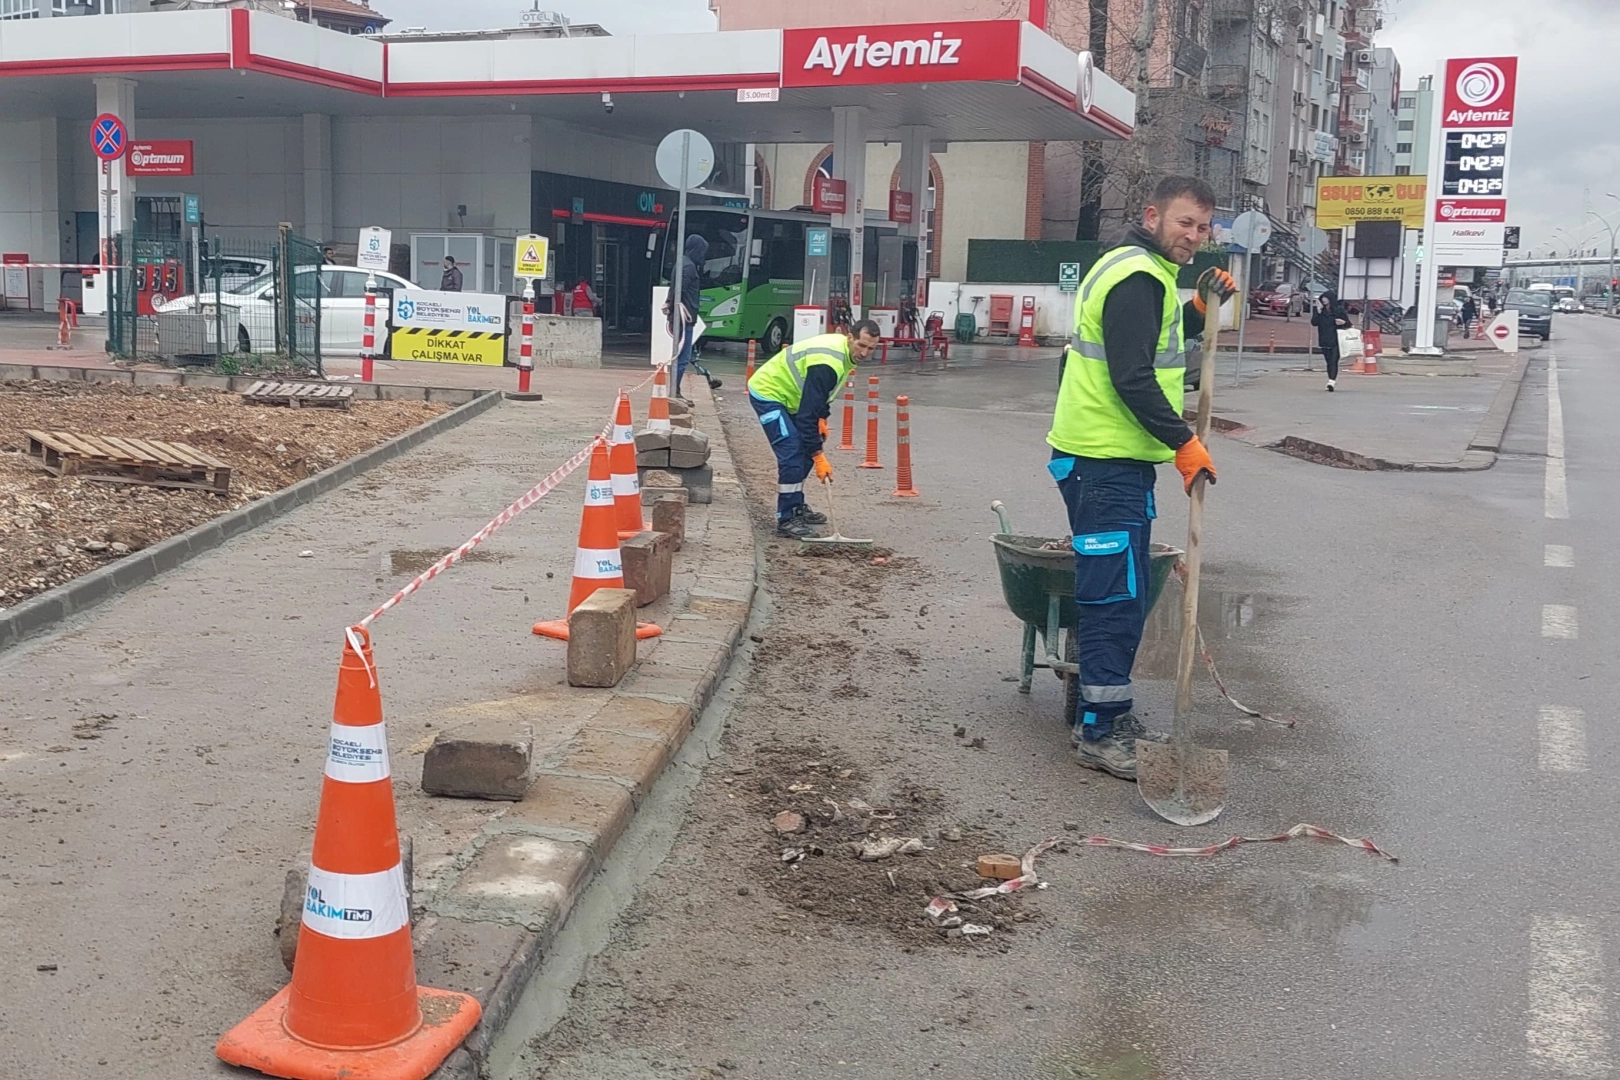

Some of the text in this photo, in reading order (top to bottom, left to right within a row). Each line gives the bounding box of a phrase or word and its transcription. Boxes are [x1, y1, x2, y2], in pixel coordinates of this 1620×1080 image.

[522, 13, 550, 21] OTEL
[804, 32, 962, 76] Aytemiz
[1446, 109, 1511, 124] Aytemiz
[1320, 186, 1363, 203] asya
[1345, 207, 1365, 215] 0850
[1366, 207, 1382, 215] 888
[1384, 207, 1390, 215] 4
[1452, 229, 1487, 237] Halkevi
[467, 306, 481, 315] YOL
[427, 338, 467, 350] DİKKAT
[412, 350, 483, 362] ÇALIŞMA VAR
